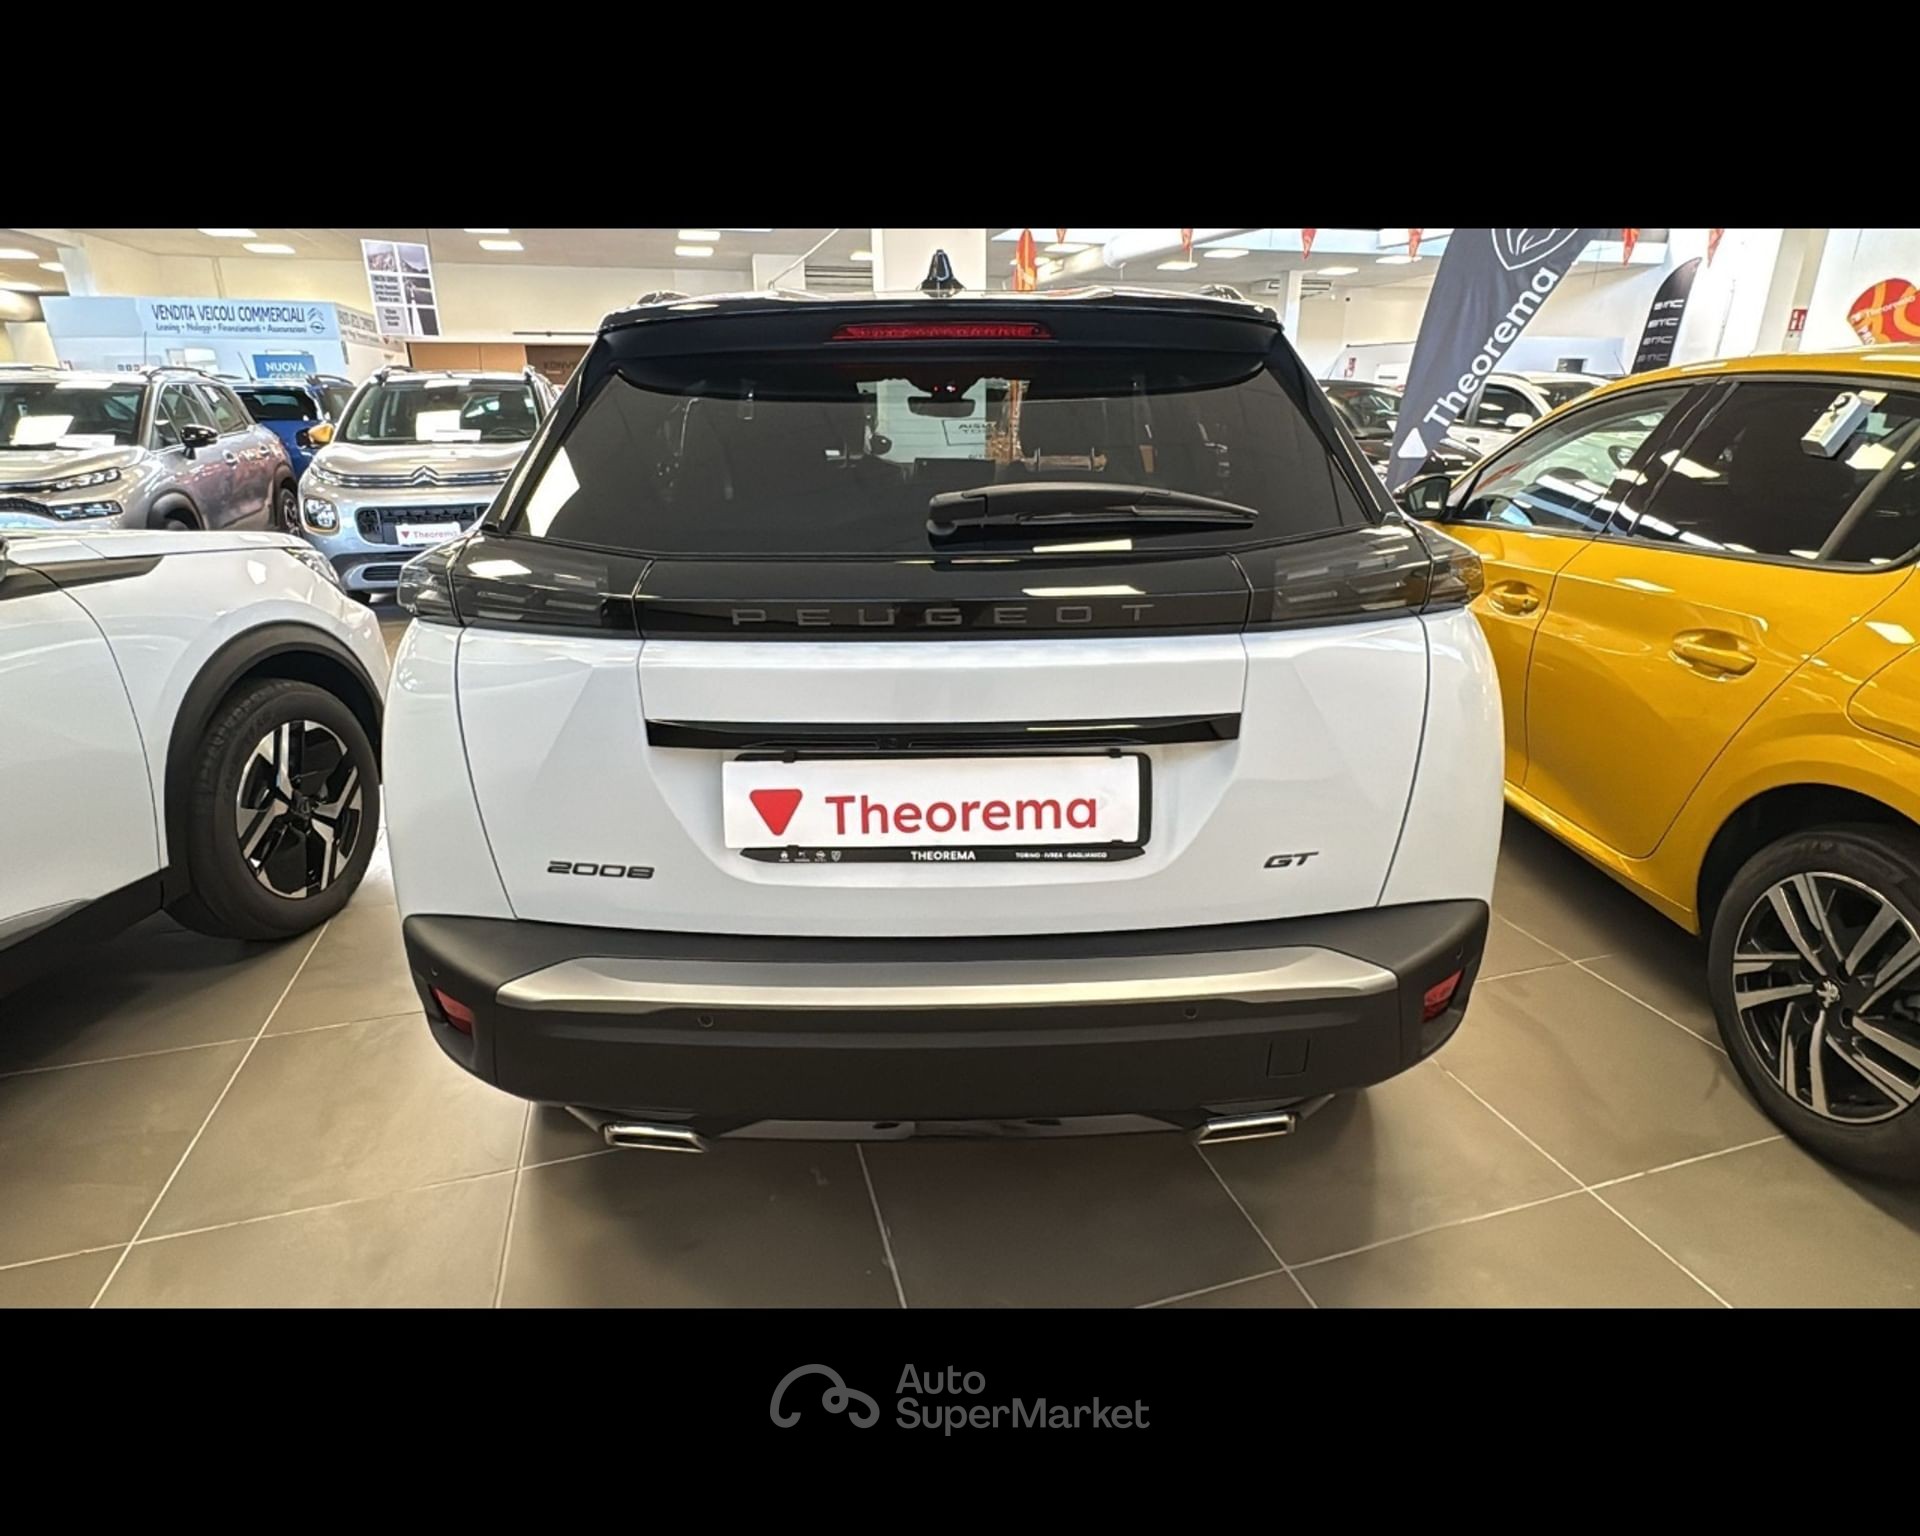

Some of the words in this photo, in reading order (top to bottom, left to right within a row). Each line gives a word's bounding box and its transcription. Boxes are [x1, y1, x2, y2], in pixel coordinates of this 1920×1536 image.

[152, 305, 195, 320] VENDITA
[198, 305, 236, 321] VEICOLI
[239, 306, 305, 322] COMMERCIALI
[1424, 267, 1559, 427] Theorema
[265, 362, 305, 372] NUOVA
[731, 603, 1155, 626] PEUGEOT
[825, 795, 1097, 834] Theorema
[911, 850, 976, 861] THEOREMA
[1264, 851, 1319, 868] GT
[547, 861, 655, 879] 2008
